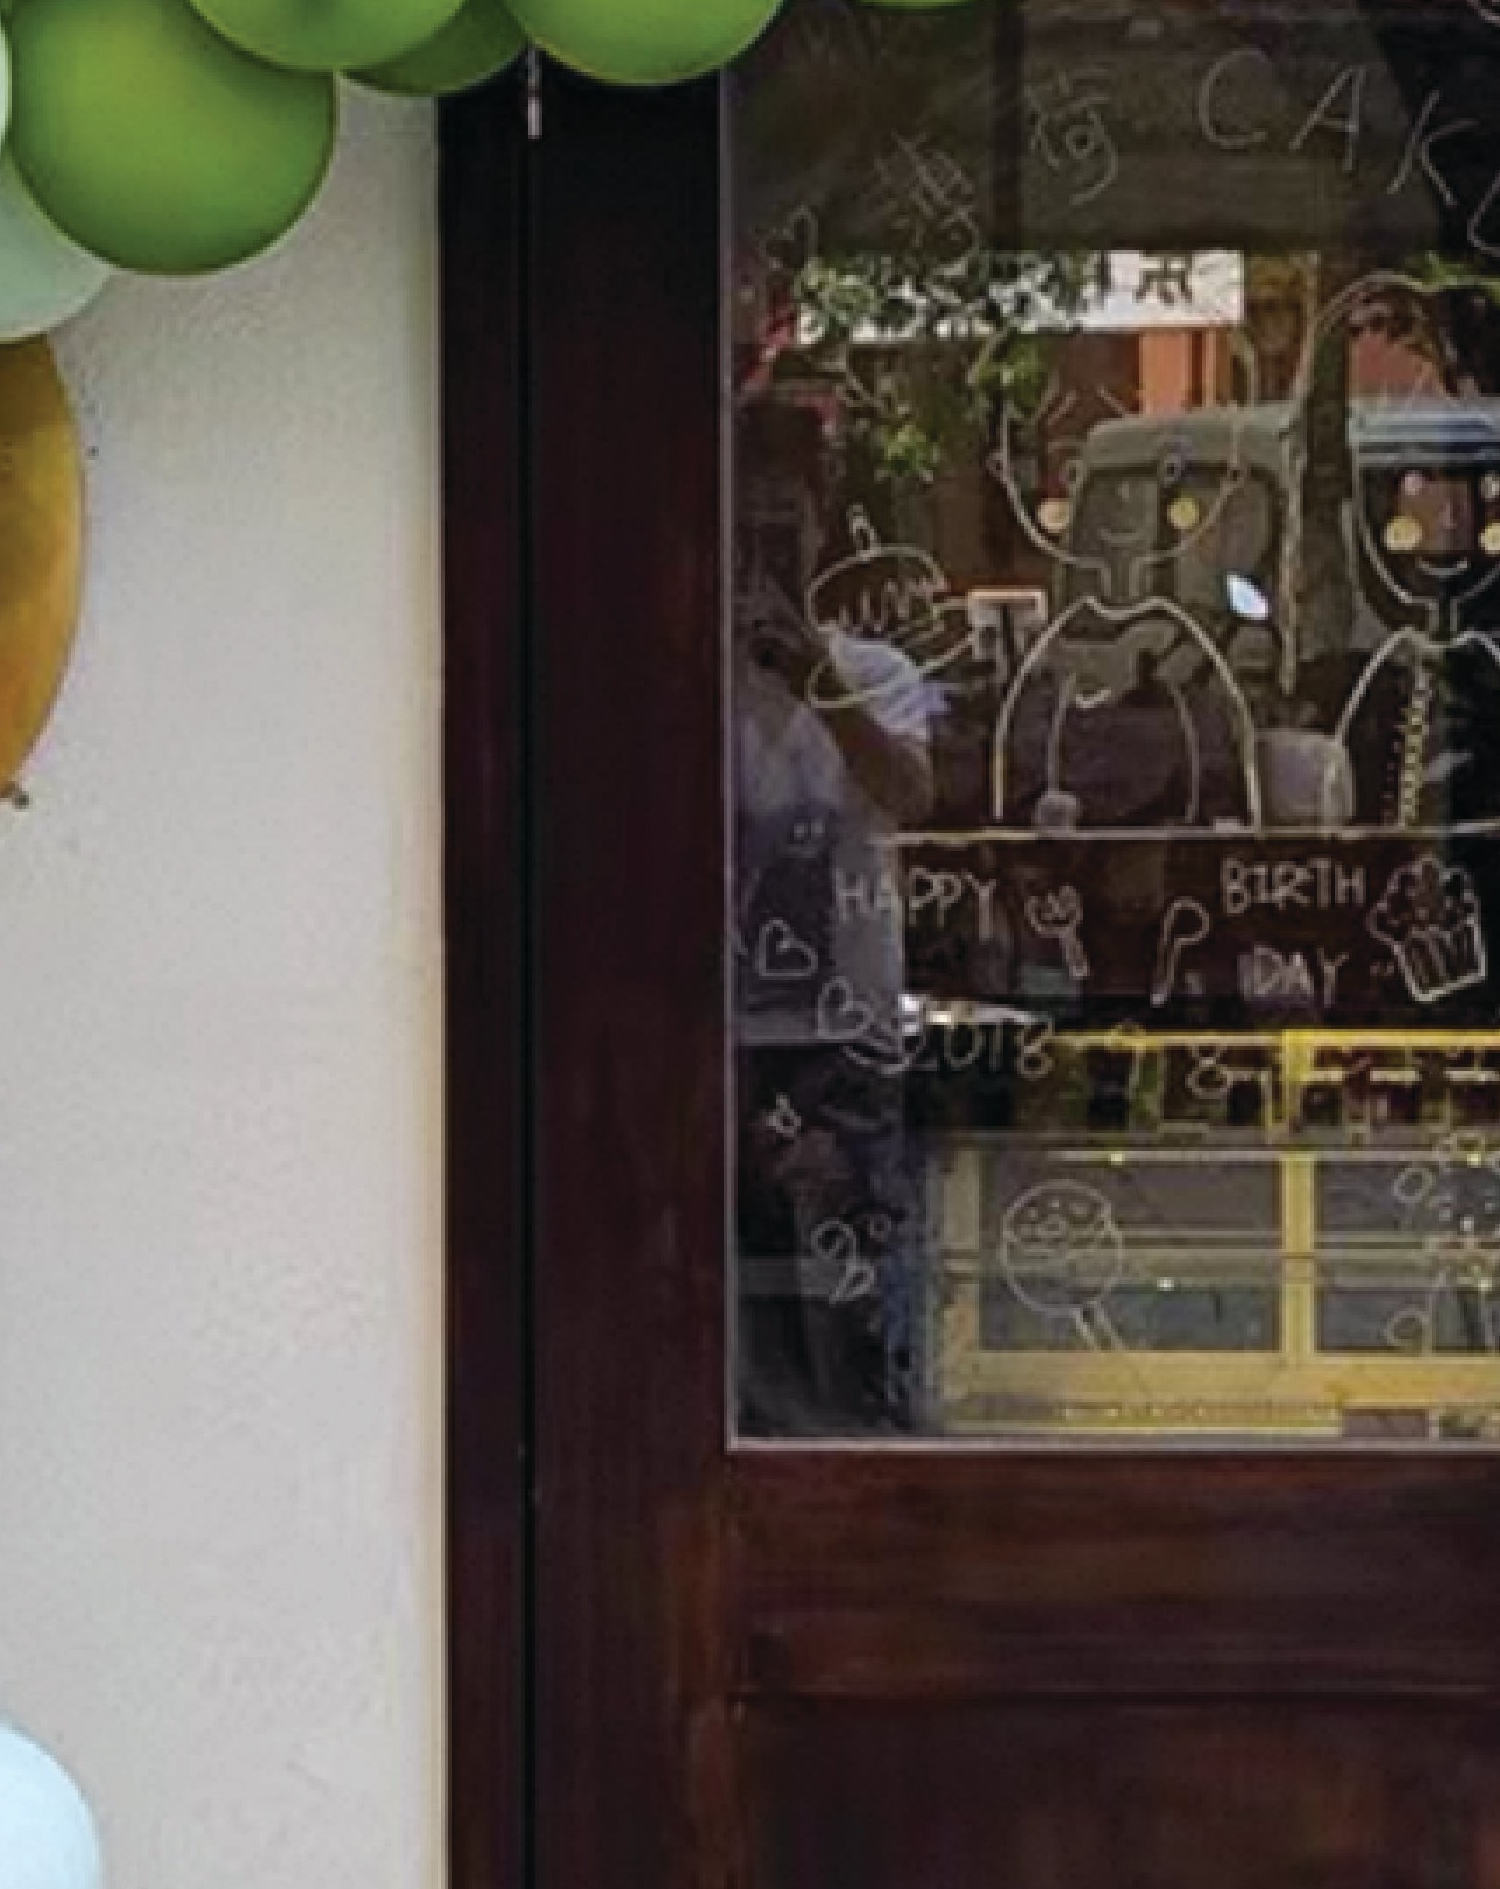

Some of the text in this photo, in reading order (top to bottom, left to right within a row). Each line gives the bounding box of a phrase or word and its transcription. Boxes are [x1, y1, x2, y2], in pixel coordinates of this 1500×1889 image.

[834, 854, 1368, 942] HAPPY BIRTH
[1252, 942, 1350, 1008] DAY
